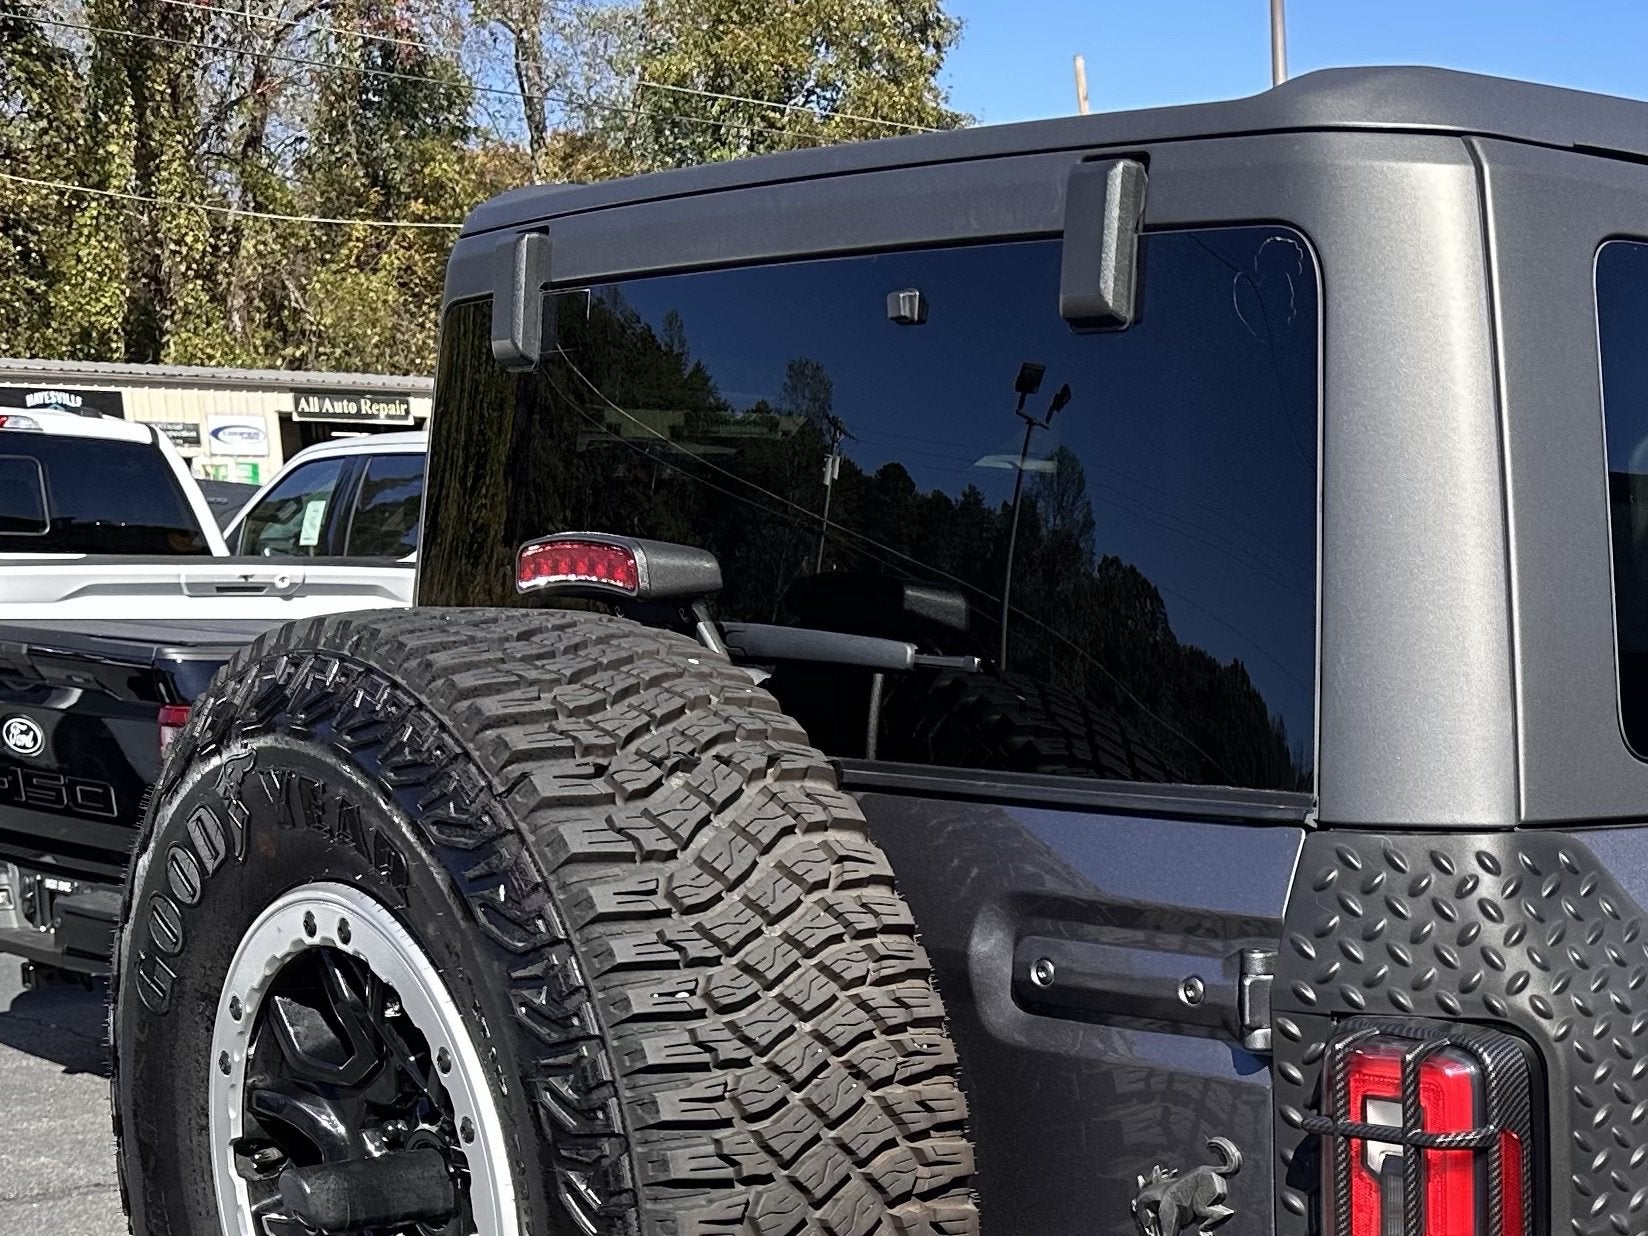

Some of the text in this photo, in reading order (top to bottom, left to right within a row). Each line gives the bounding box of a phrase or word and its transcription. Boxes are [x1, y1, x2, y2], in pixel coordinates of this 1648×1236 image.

[298, 396, 408, 419] All Auto Repair
